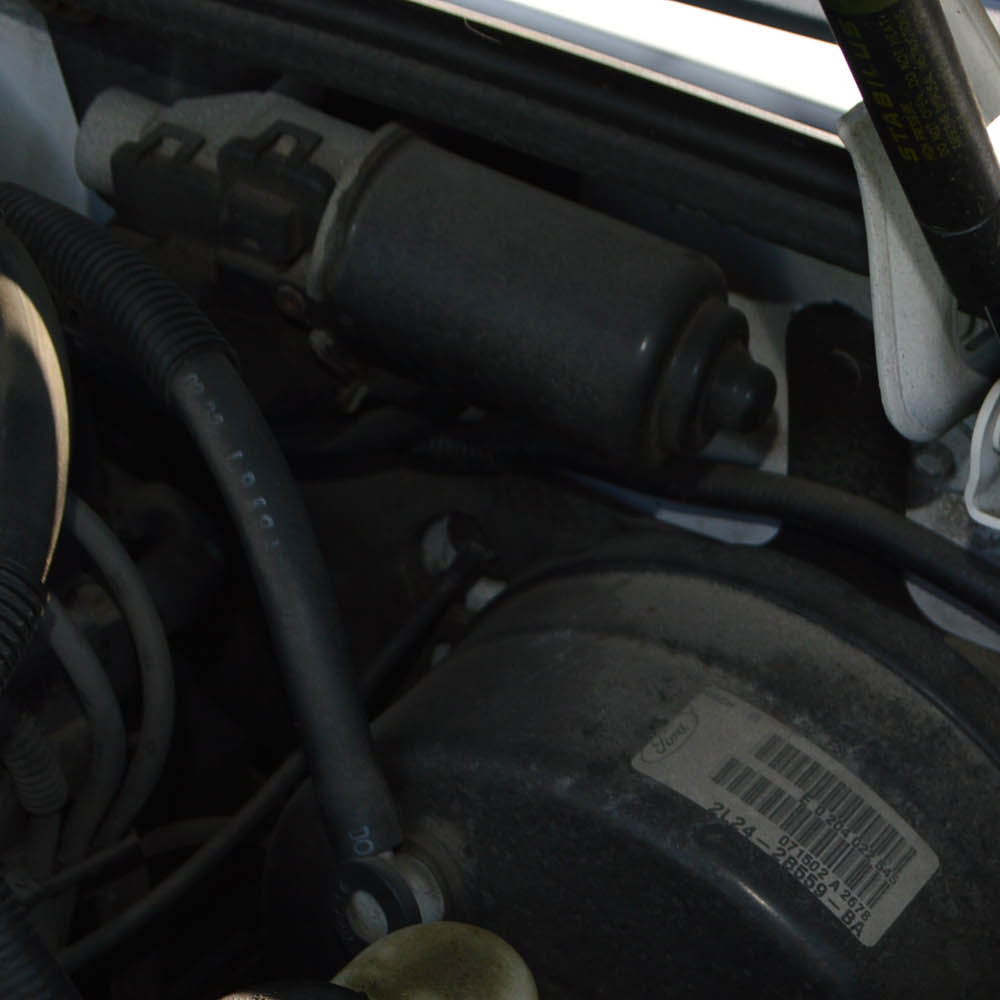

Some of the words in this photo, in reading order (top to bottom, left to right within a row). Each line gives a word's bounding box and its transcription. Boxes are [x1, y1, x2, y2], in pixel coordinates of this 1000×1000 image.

[839, 18, 919, 162] STABILUS
[777, 835, 829, 880] 071502
[829, 879, 842, 893] A
[840, 888, 872, 922] 2678
[826, 815, 850, 839] 204
[851, 836, 875, 860] 022
[874, 860, 899, 886] 545
